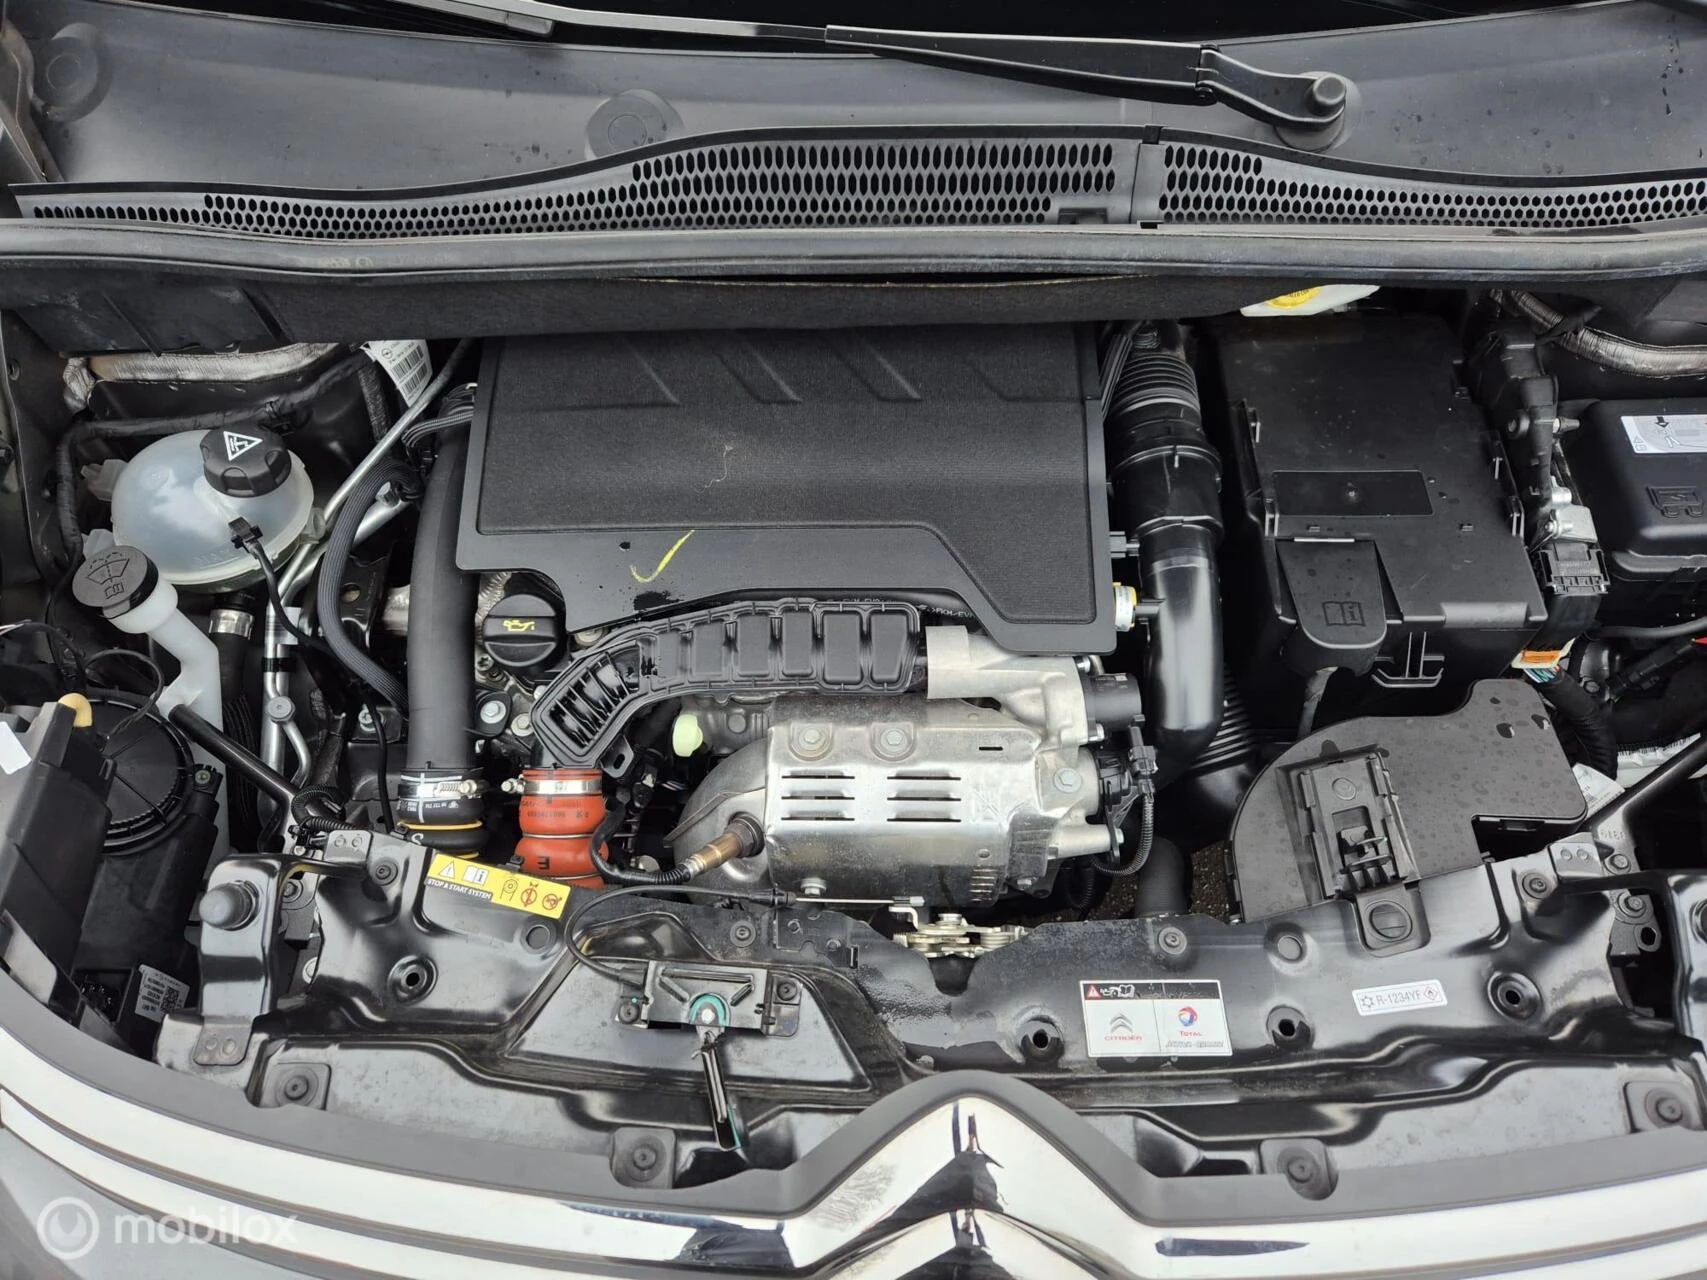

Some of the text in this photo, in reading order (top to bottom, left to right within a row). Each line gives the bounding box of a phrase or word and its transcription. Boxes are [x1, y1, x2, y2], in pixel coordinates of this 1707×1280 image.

[427, 878, 444, 887] STOP
[449, 884, 468, 893] START
[468, 889, 491, 899] SYSTEM
[1376, 989, 1421, 1005] R-1234YF
